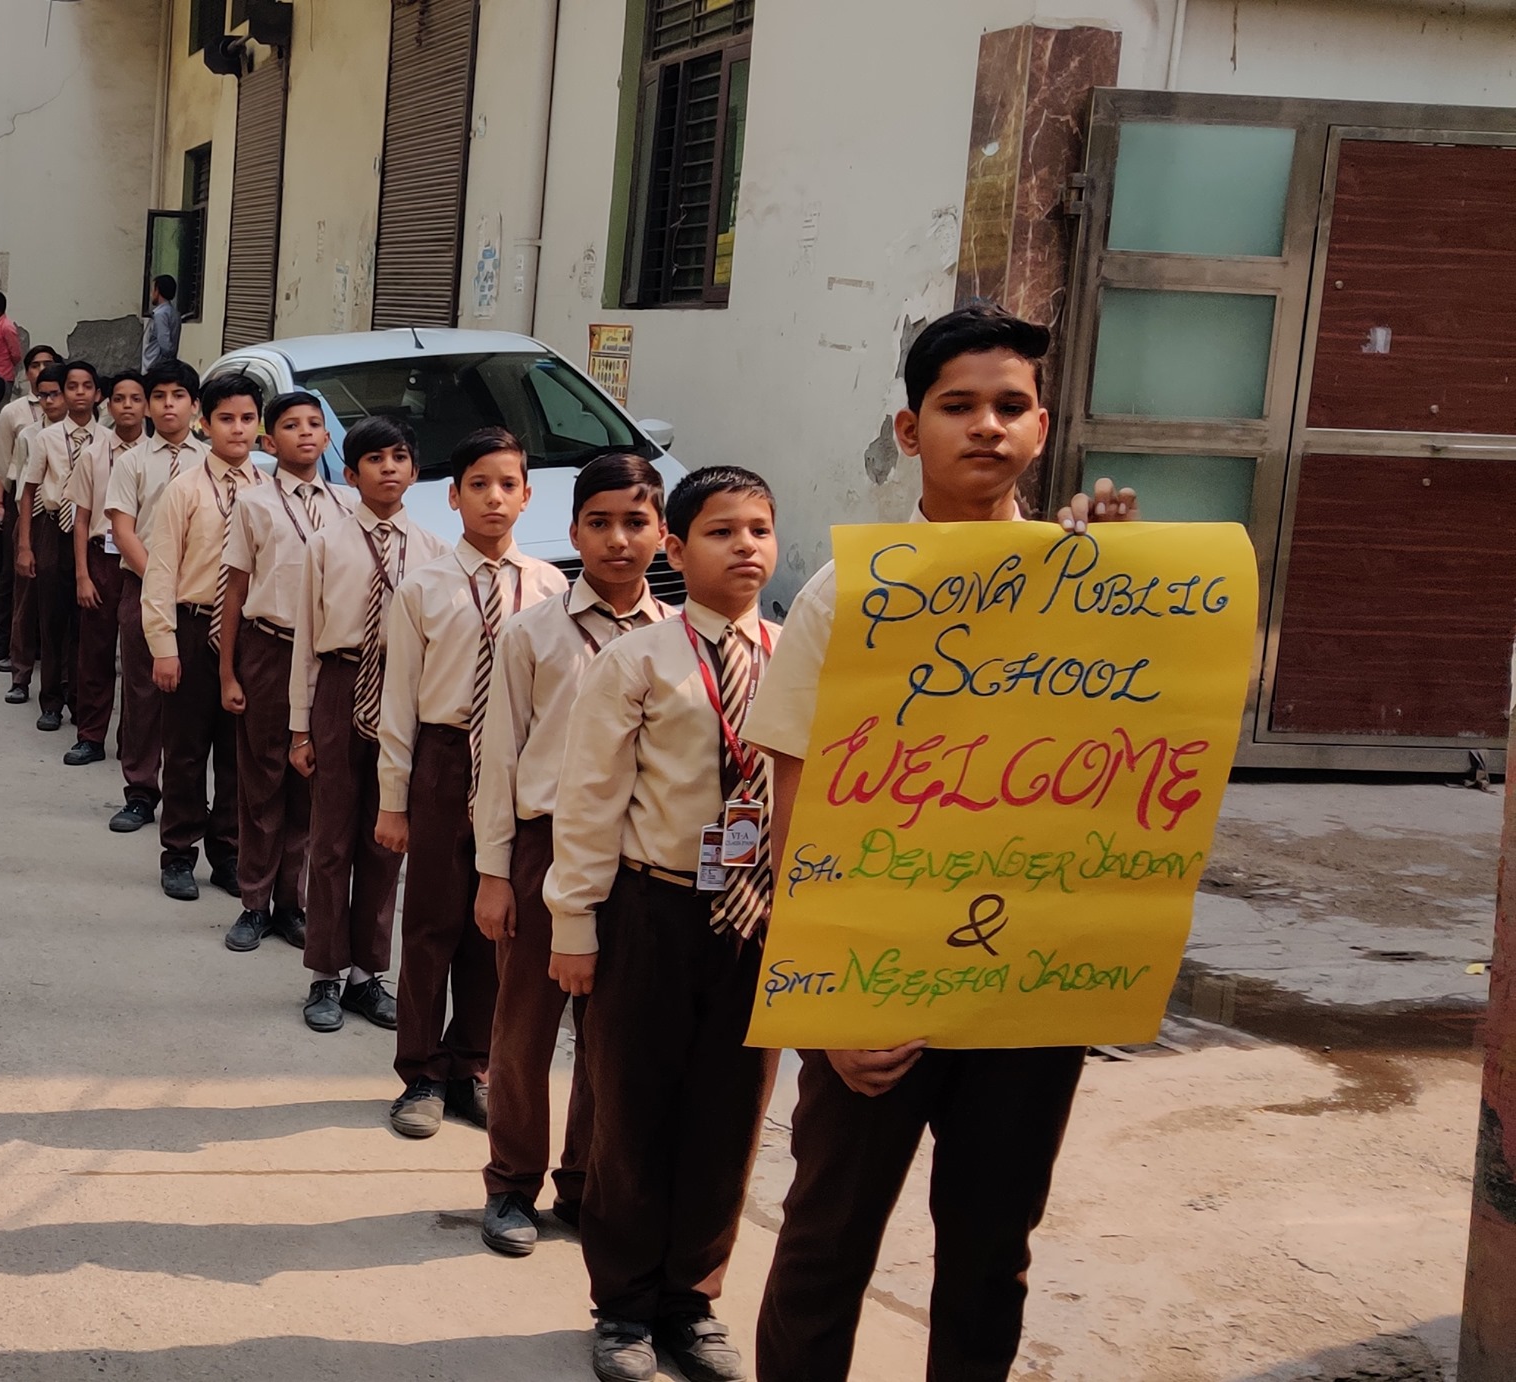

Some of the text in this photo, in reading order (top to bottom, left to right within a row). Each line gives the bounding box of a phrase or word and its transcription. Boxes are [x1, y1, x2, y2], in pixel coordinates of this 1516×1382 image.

[860, 531, 1230, 649] SONA PUBLIC
[896, 624, 1161, 726] SCHOOL
[821, 715, 1212, 831] WELCOME
[848, 827, 1077, 893] DEVENDER
[1079, 831, 1205, 881] YADAV
[946, 893, 1009, 957] &
[839, 947, 1007, 1008] NEESHA
[1018, 949, 1154, 993] YADAV
